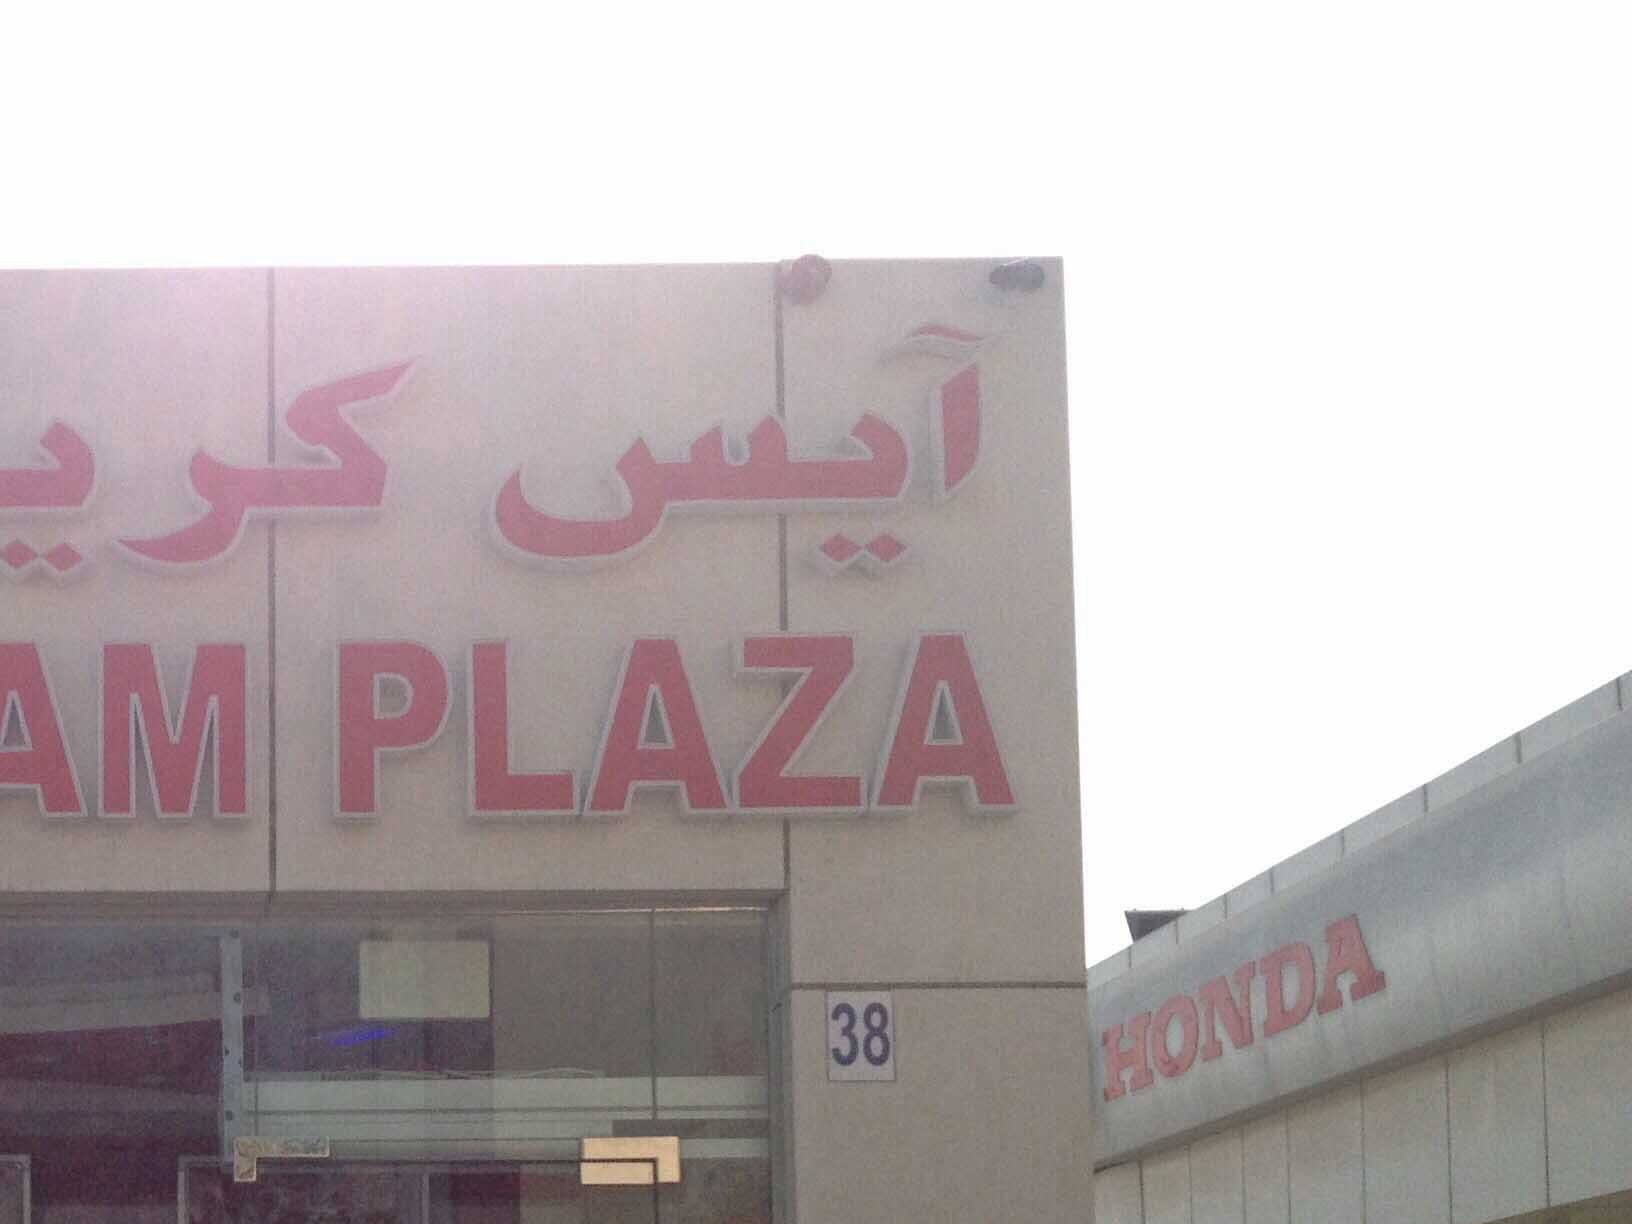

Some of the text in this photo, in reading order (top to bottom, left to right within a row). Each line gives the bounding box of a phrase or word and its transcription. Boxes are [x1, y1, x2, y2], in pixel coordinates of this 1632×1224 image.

[493, 323, 985, 563] آيس
[335, 632, 1017, 815] PLAZA
[831, 1002, 890, 1066] 38
[1102, 913, 1386, 1102] HONDA
